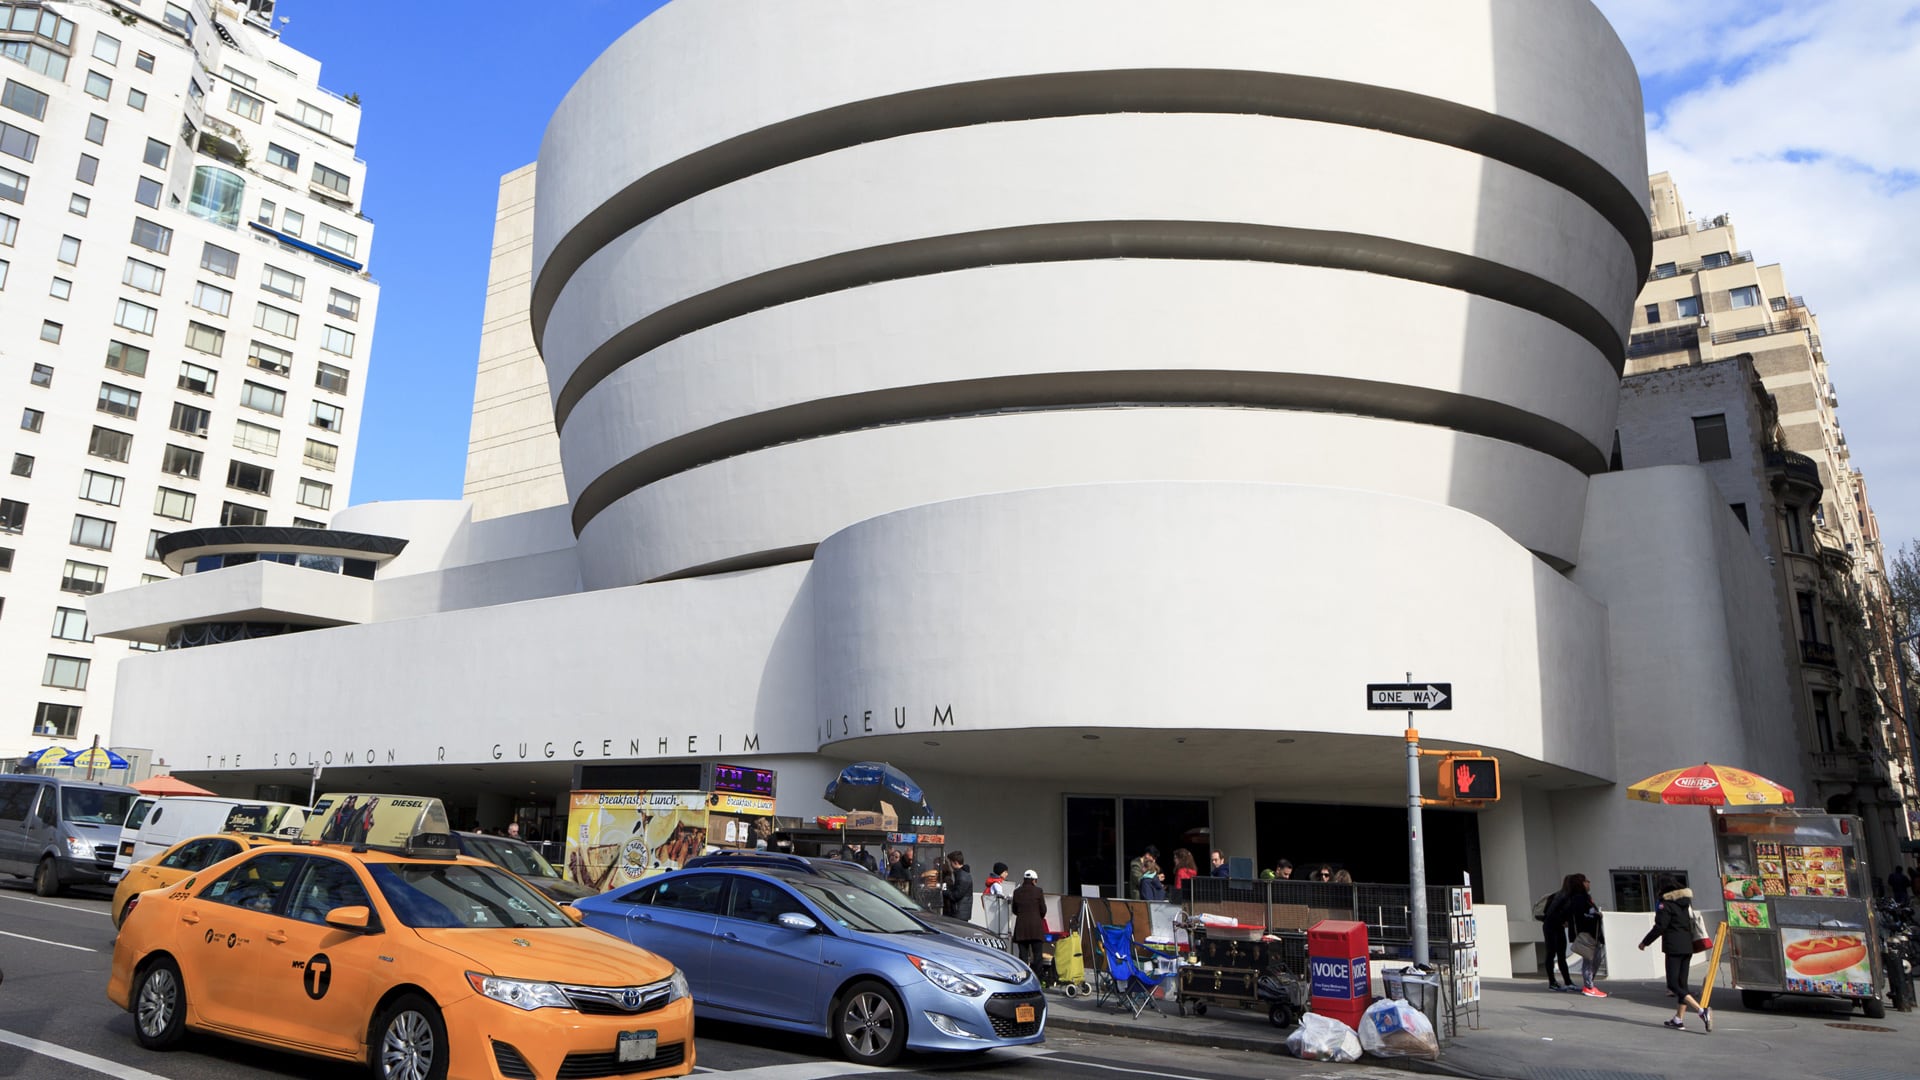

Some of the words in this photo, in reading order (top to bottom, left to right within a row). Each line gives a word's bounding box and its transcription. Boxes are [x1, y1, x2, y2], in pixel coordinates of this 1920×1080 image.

[1378, 691, 1403, 703] ONE
[1413, 691, 1439, 703] WAY
[206, 754, 242, 768] THE
[273, 748, 395, 767] SOLOMON
[437, 746, 445, 761] R
[492, 733, 760, 760] GUGGENHEIM
[391, 799, 424, 808] DIESEL
[598, 794, 641, 807] Breakfast
[649, 795, 677, 806] Lunch
[291, 960, 305, 969] NYC
[1314, 962, 1349, 979] VOICE
